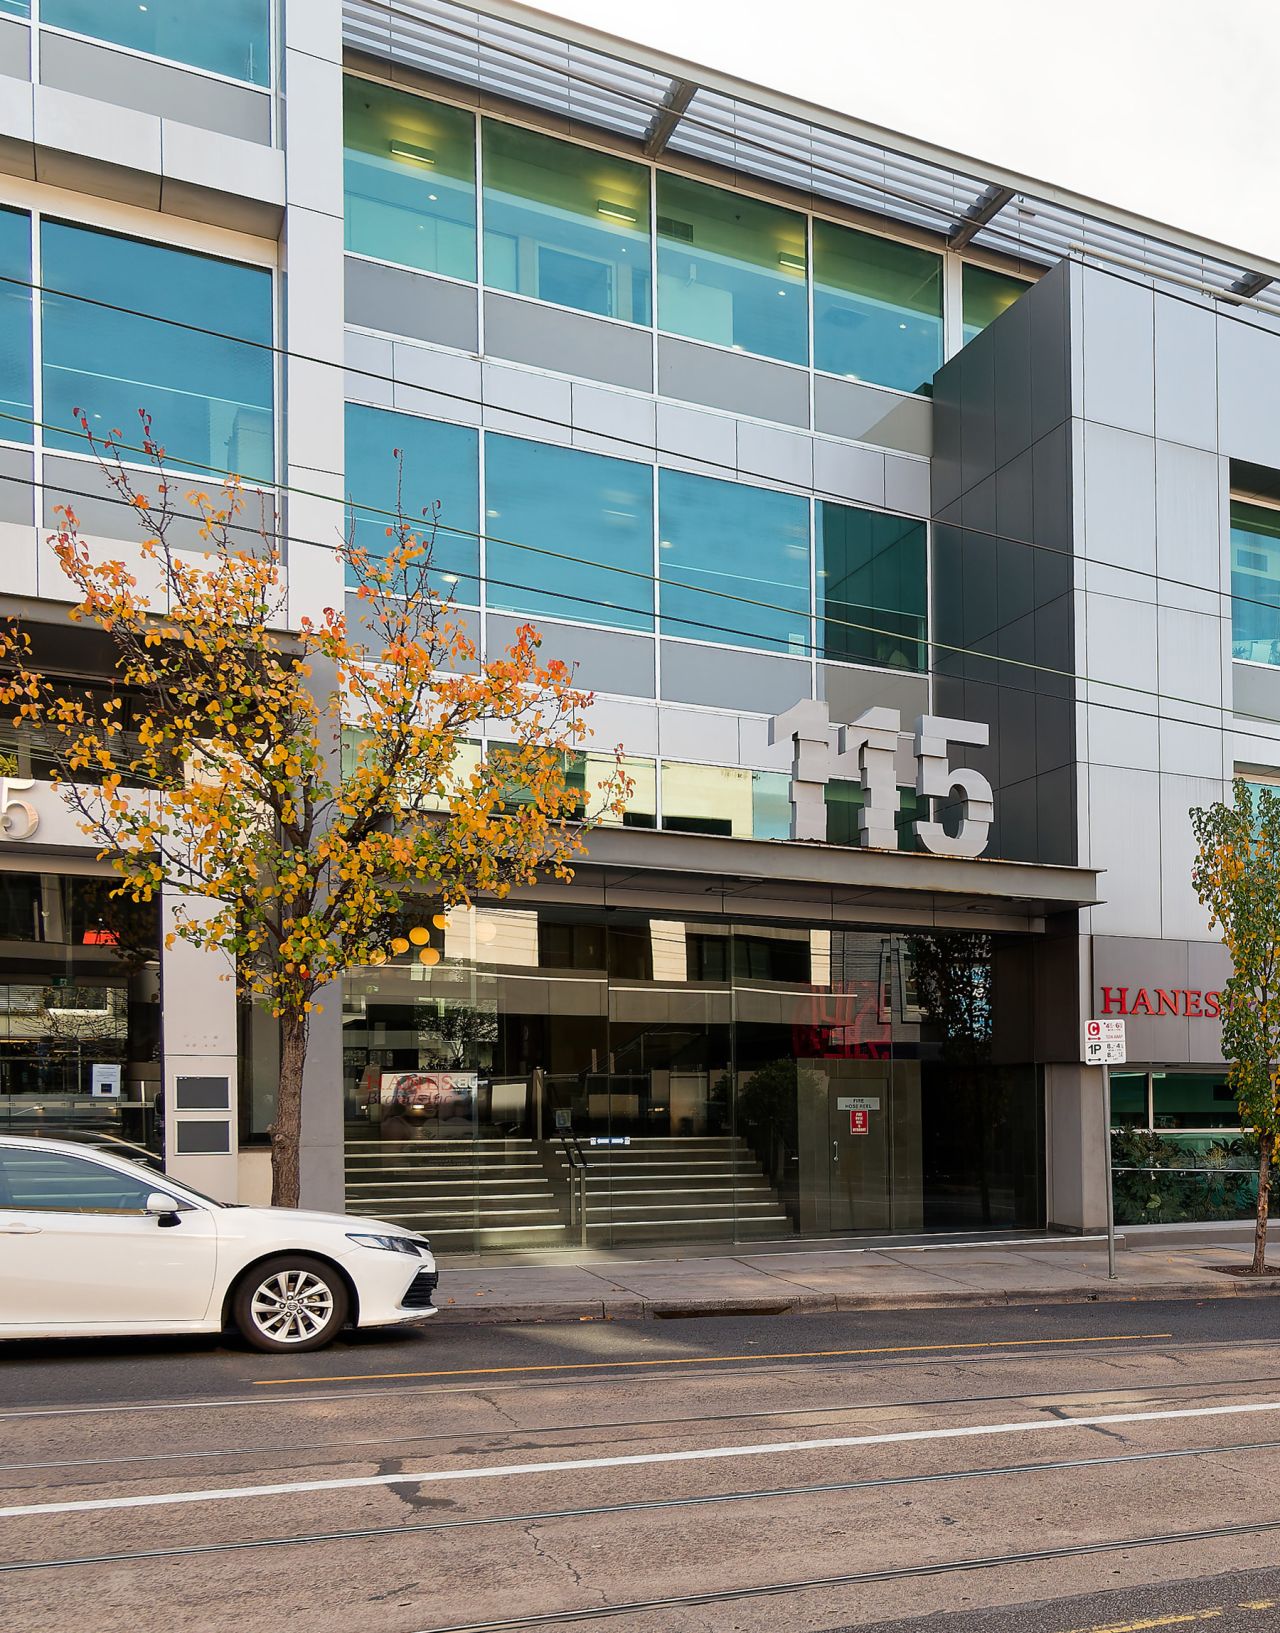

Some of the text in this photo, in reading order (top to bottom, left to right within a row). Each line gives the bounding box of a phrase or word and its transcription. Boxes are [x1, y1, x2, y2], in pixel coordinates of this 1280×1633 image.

[768, 699, 994, 857] 115
[0, 777, 39, 840] 5
[1100, 986, 1222, 1018] HANES
[1088, 1044, 1101, 1055] 1P
